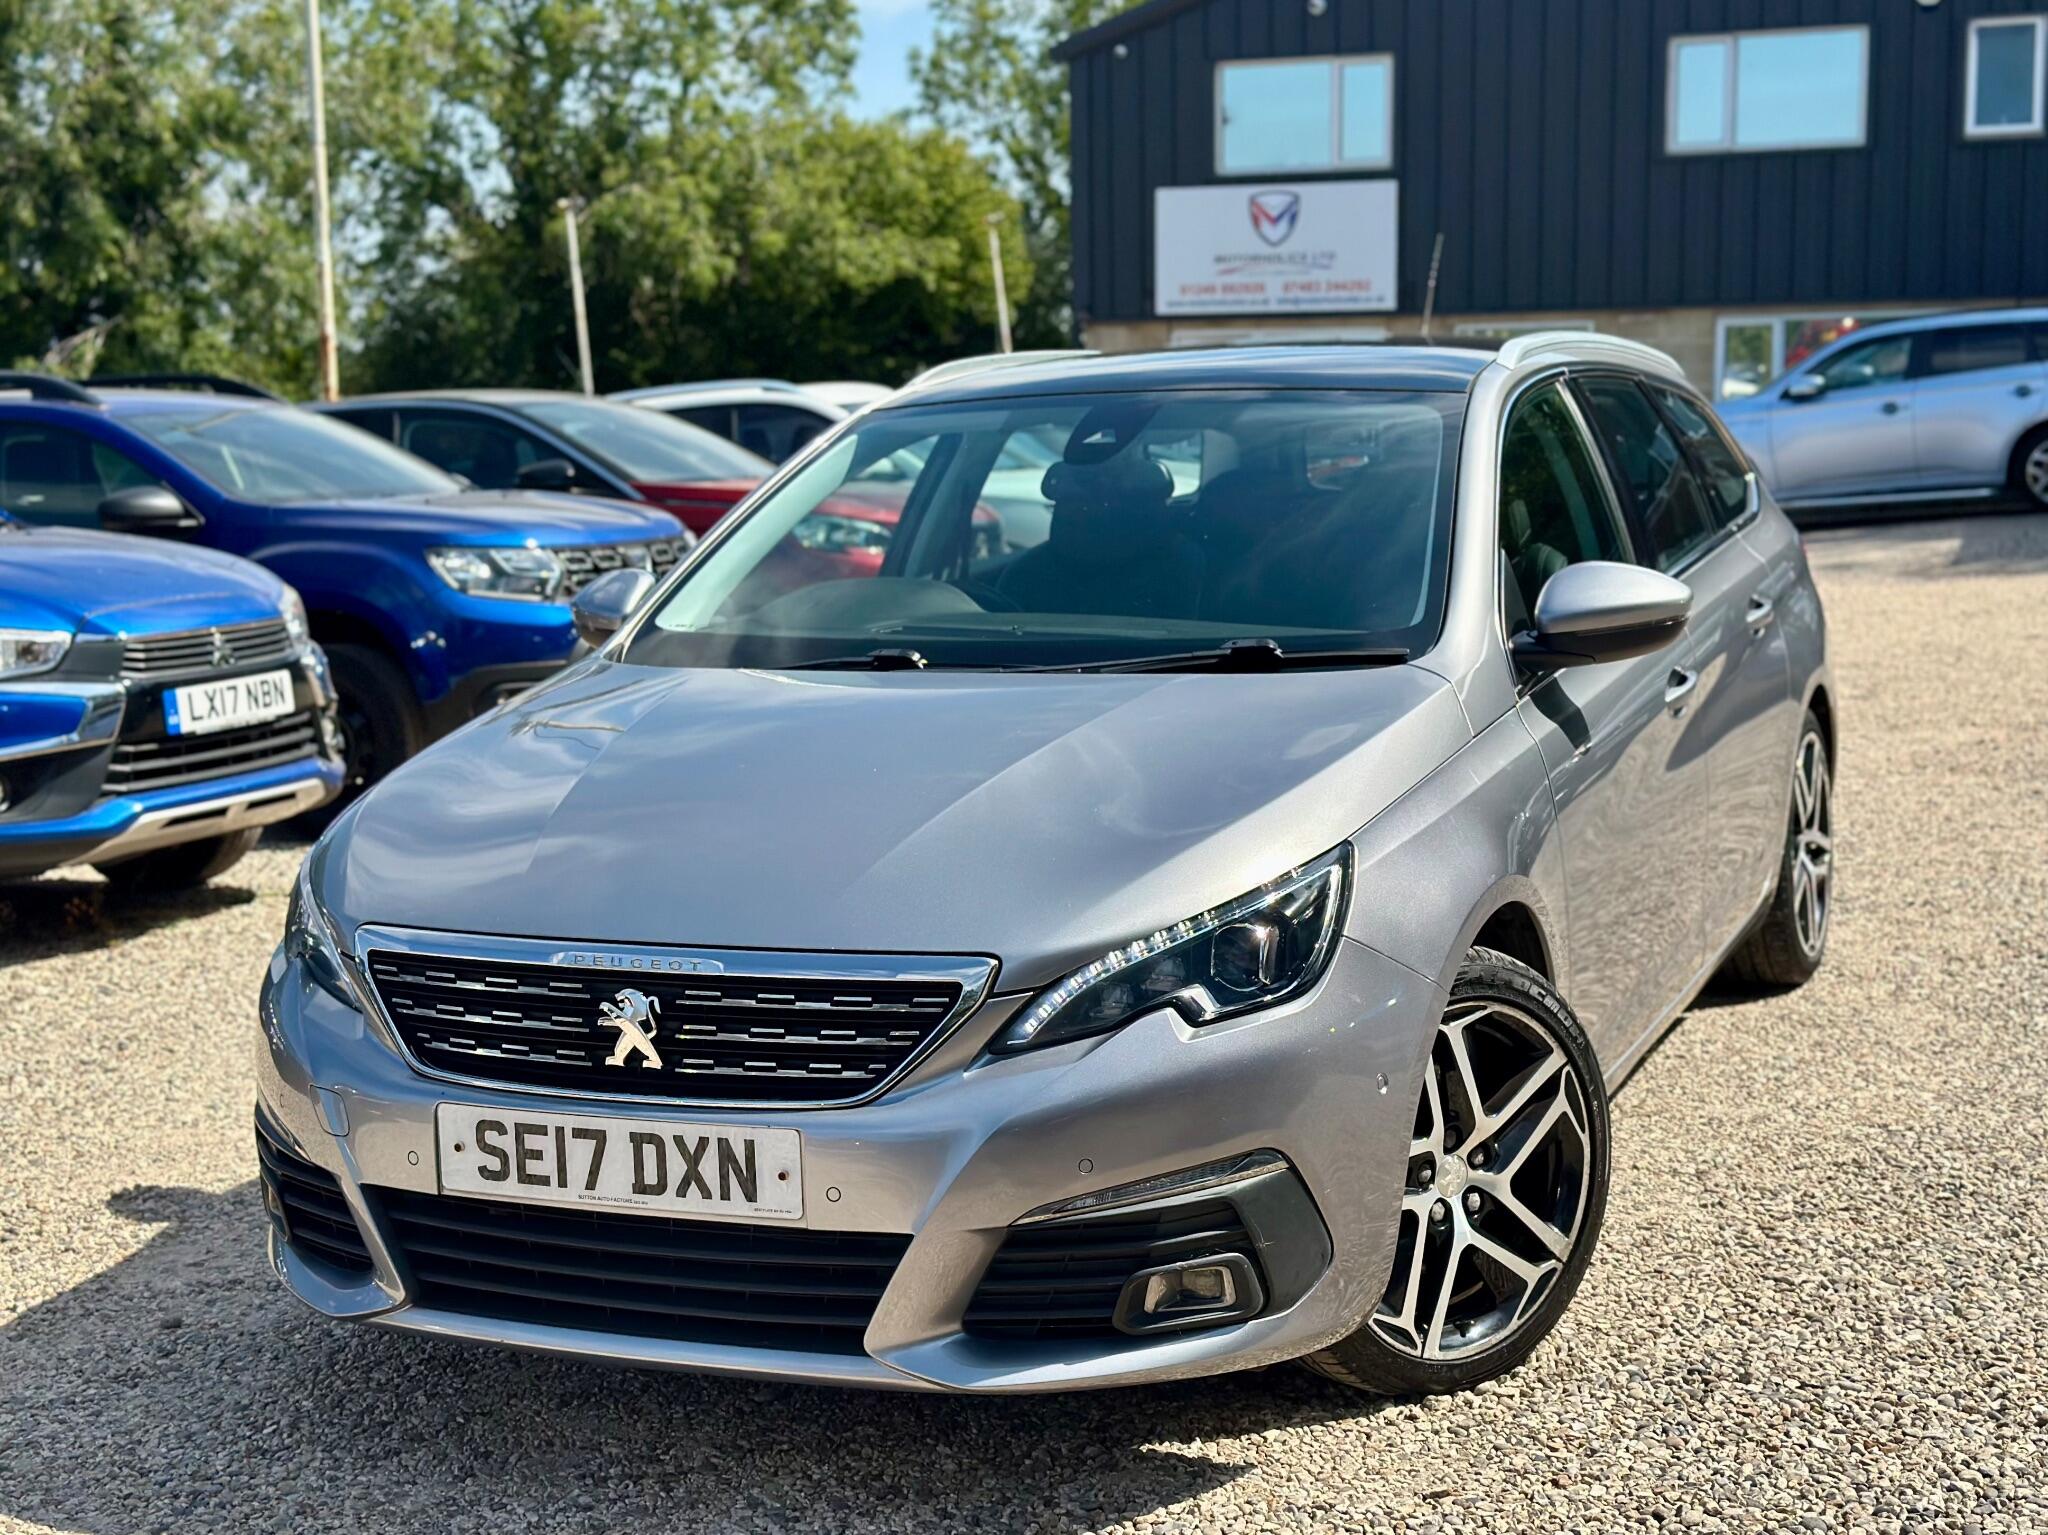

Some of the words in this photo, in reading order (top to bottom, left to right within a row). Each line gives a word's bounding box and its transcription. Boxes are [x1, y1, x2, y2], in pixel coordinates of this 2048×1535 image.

[187, 685, 238, 722] LX17
[245, 676, 286, 712] NBN
[573, 954, 701, 972] PEUGEOT
[474, 1118, 608, 1191] SE17
[628, 1130, 758, 1203] DXN
